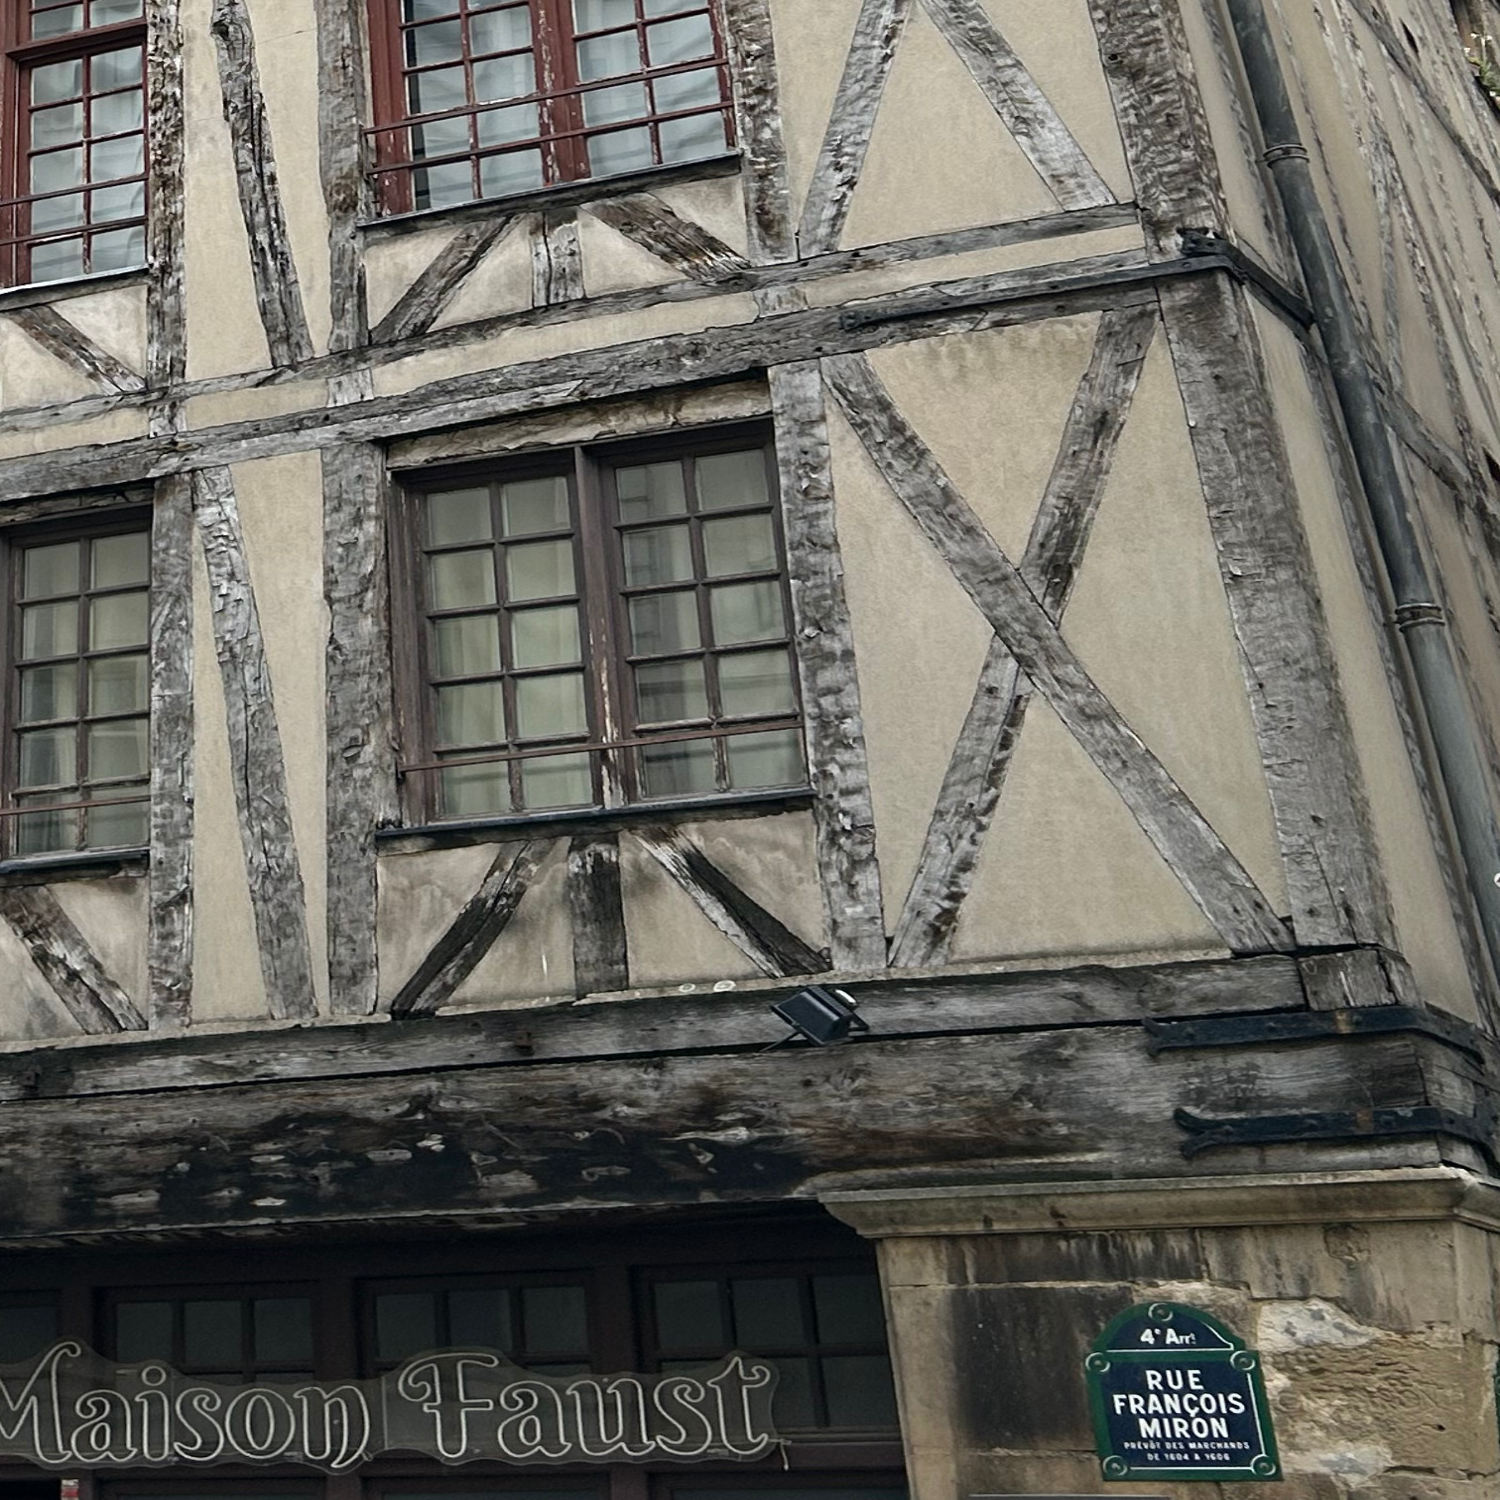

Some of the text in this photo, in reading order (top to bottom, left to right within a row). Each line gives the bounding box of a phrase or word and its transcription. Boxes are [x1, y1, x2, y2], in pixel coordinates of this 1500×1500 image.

[1145, 1369, 1204, 1391] RUE
[397, 1351, 772, 1458] Faust
[1112, 1392, 1246, 1418] FRANÇOIS
[1138, 1417, 1229, 1439] MIRON
[1165, 1441, 1185, 1450] DES
[1188, 1441, 1250, 1450] MARCHANDS
